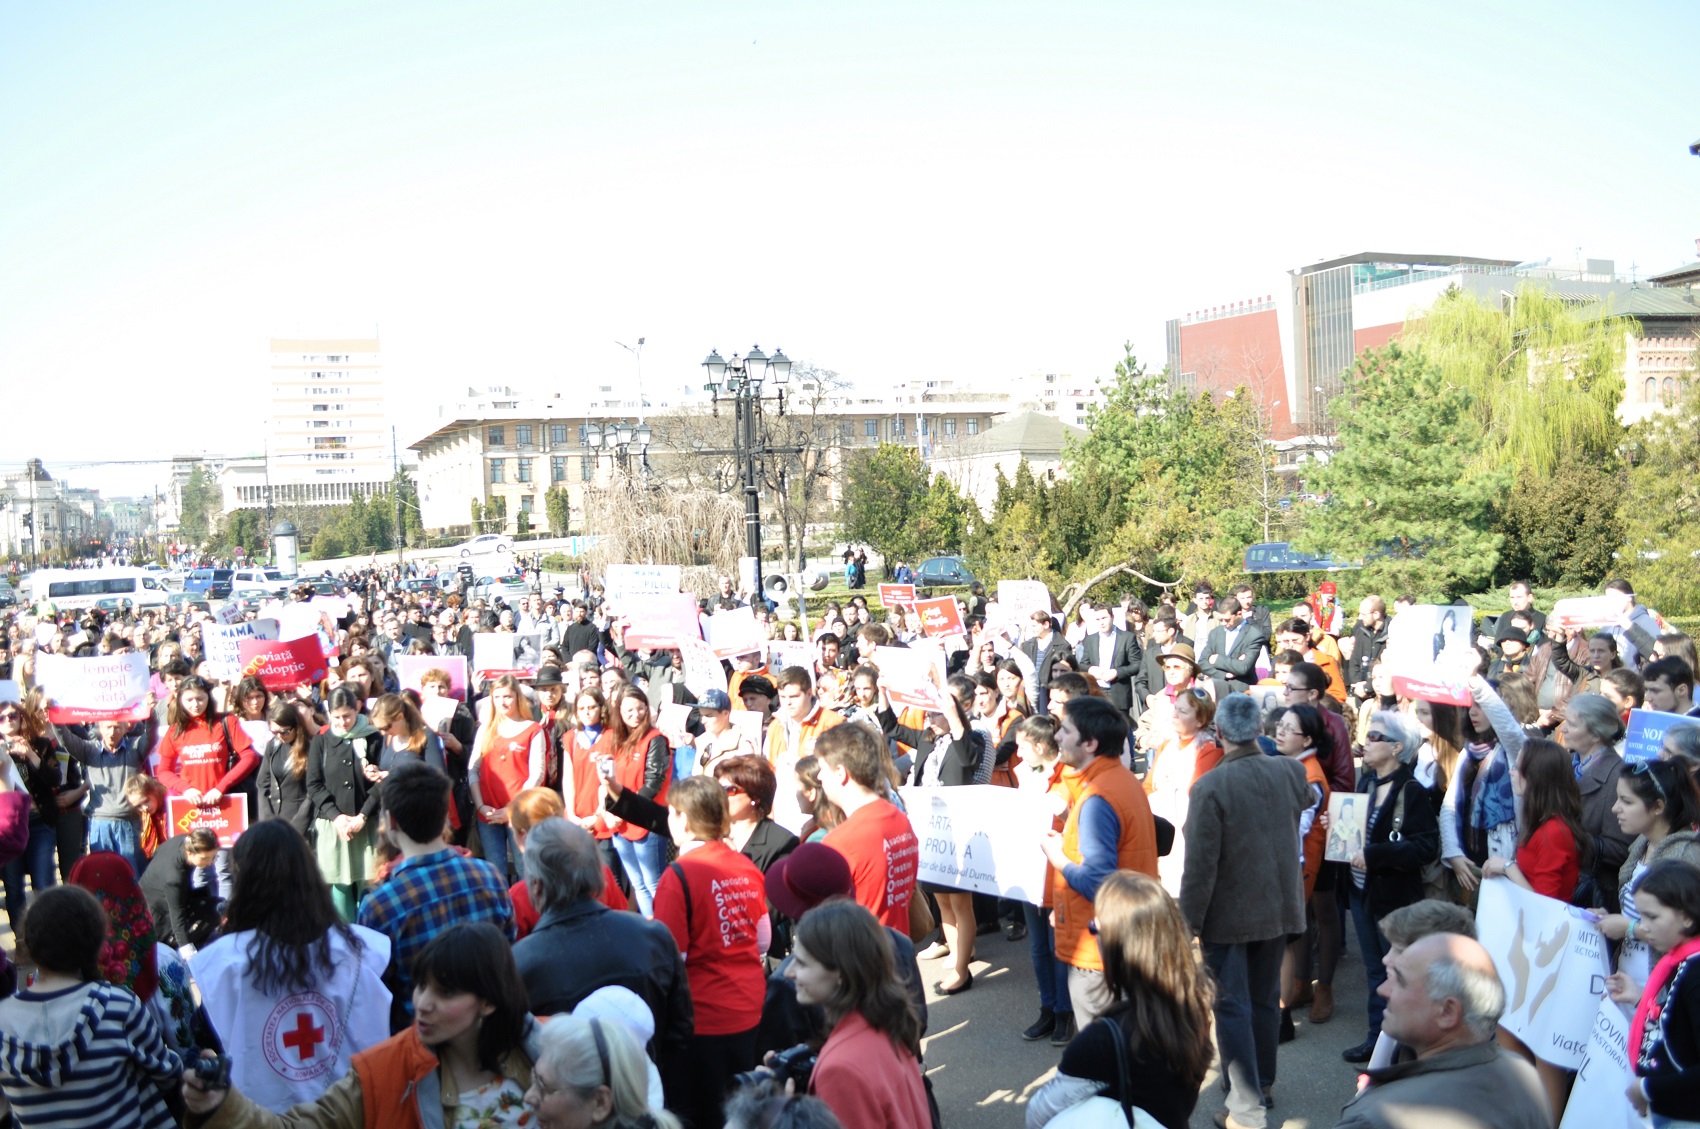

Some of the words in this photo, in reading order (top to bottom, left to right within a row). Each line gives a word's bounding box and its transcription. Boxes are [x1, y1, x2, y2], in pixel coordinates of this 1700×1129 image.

[221, 624, 254, 638] MAMA
[242, 655, 266, 676] pro
[264, 650, 291, 663] viață
[258, 661, 305, 677] adopție
[178, 809, 198, 832] pro
[190, 818, 229, 829] adopție
[925, 838, 948, 854] PRO
[939, 862, 946, 874] la
